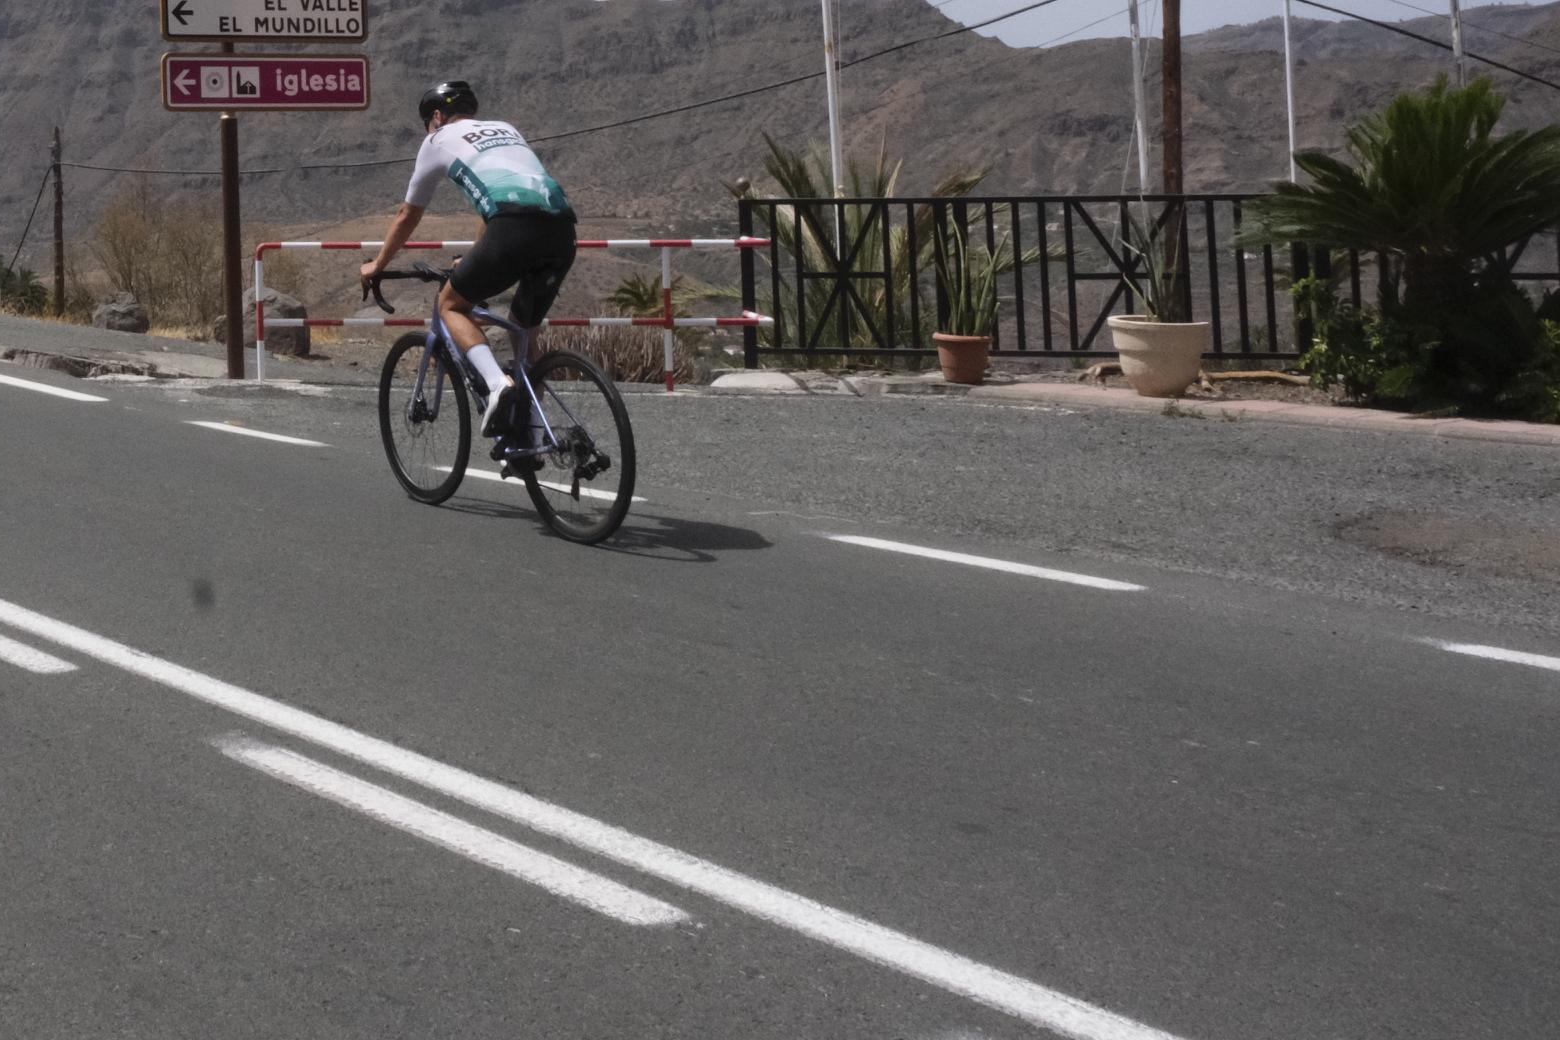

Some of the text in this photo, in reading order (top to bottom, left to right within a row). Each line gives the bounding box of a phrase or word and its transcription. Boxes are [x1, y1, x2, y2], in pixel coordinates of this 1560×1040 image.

[219, 16, 360, 35] EL MUNDILLO
[275, 68, 361, 96] iglesia
